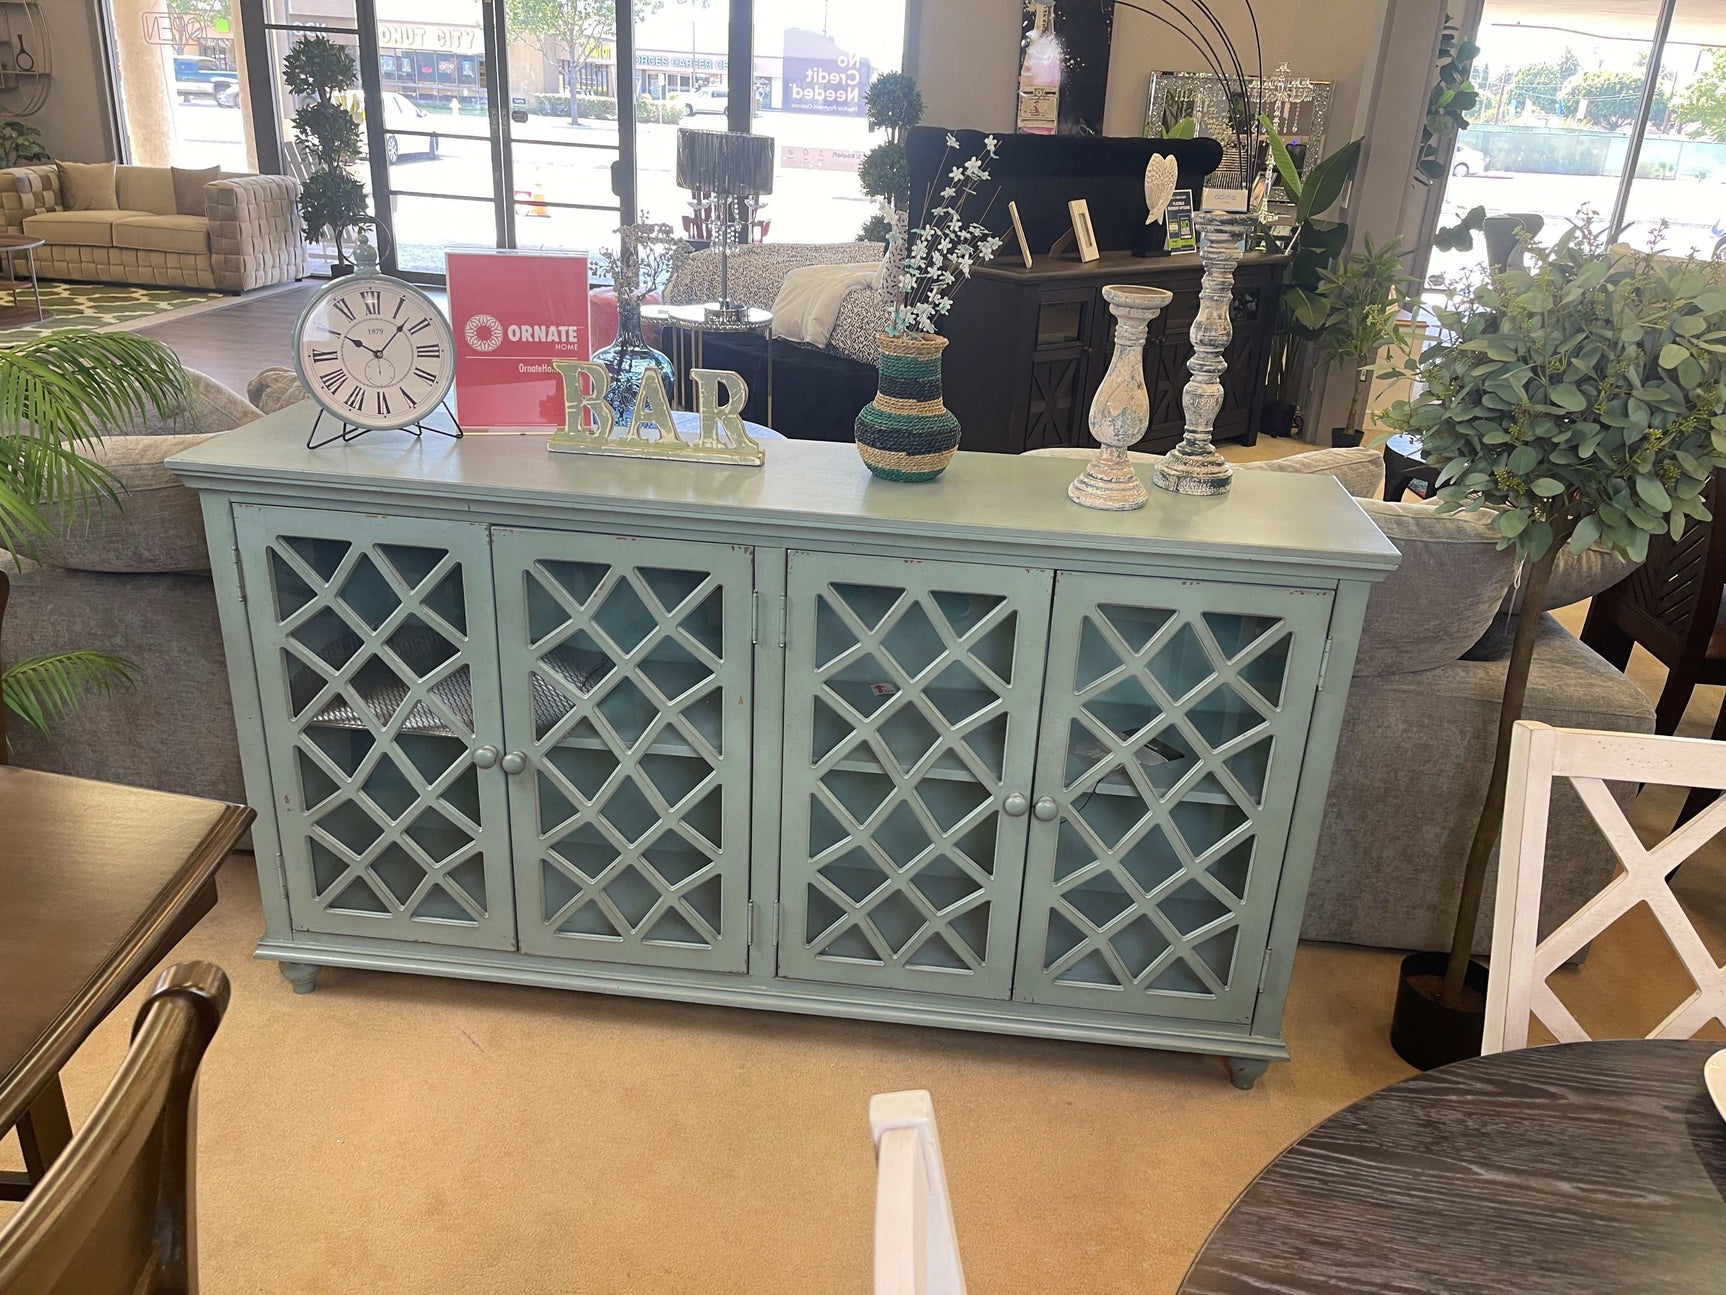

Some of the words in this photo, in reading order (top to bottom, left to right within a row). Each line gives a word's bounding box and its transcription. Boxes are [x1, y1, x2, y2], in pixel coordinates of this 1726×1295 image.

[437, 28, 475, 49] CITY
[671, 56, 713, 70] CAREER
[367, 328, 384, 336] 1879
[507, 324, 578, 342] ORNATE
[518, 363, 559, 373] OrnateHo
[552, 359, 760, 453] BAR
